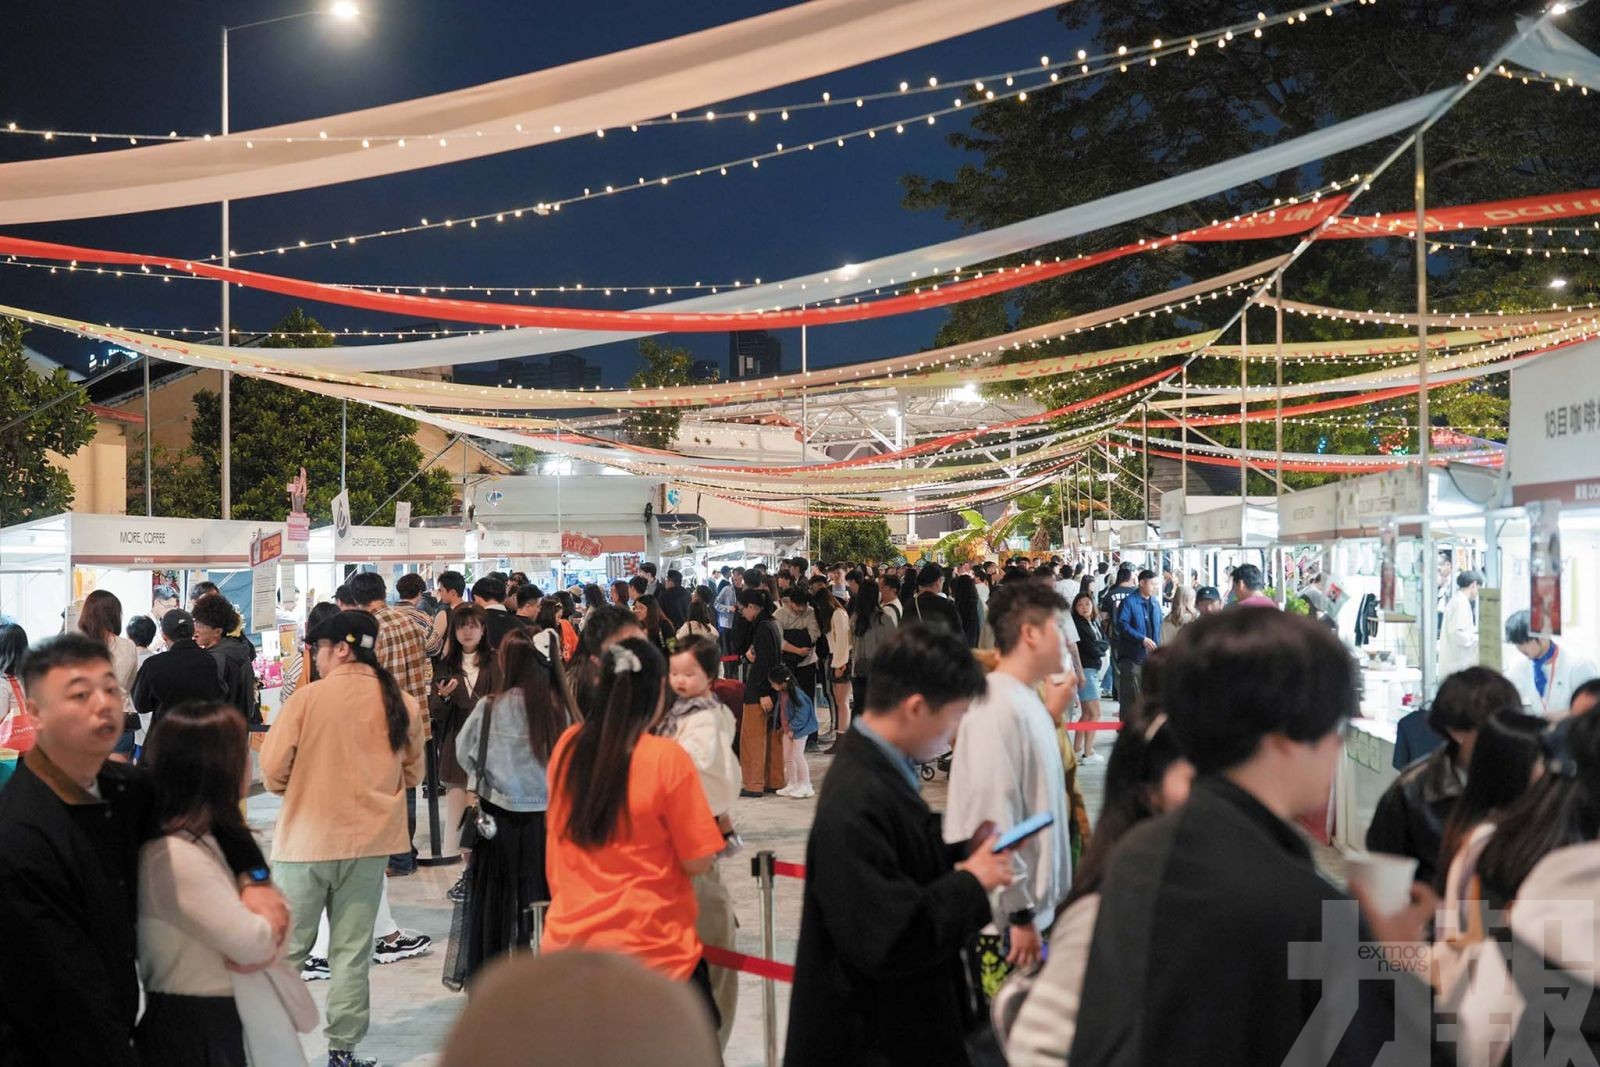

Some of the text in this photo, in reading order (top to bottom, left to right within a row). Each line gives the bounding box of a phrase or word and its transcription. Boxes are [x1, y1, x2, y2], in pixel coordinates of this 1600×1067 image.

[1545, 398, 1600, 440] 18目咖啡
[119, 531, 166, 544] MORE, COFFEE
